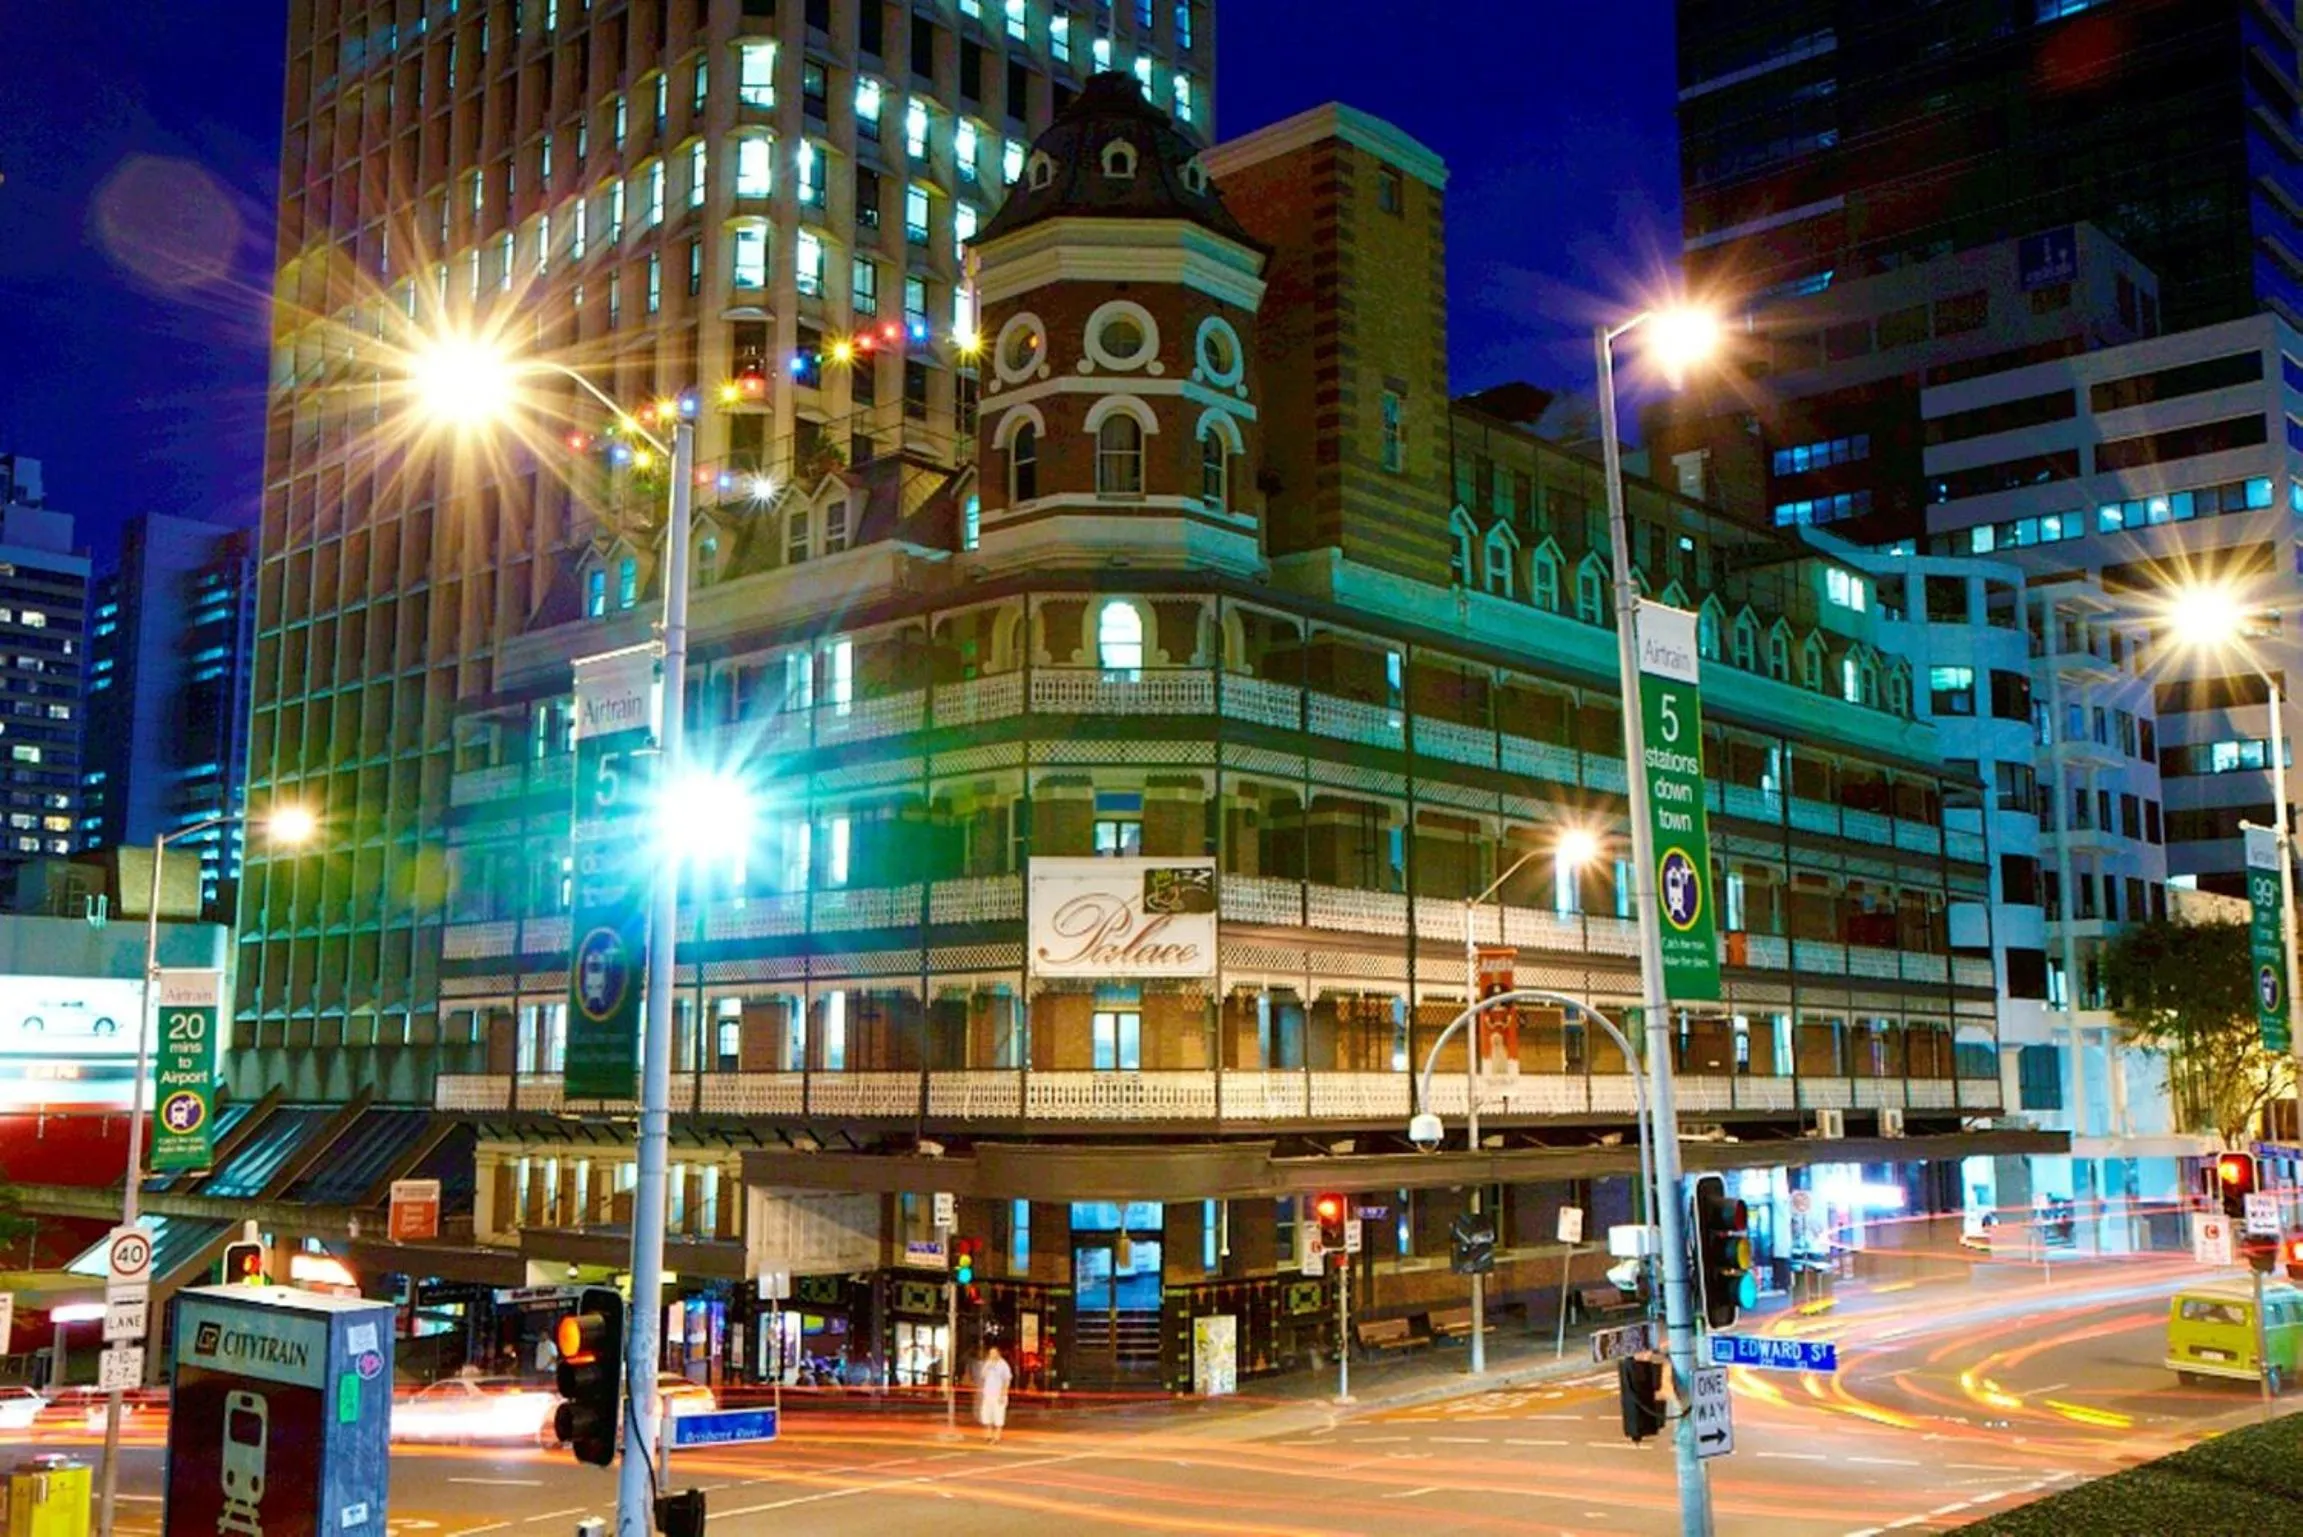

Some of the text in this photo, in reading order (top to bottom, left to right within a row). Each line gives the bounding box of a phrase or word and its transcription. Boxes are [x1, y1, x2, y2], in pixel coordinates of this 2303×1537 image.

[1643, 638, 1691, 674] Airtrain
[582, 690, 642, 726] Airtrain
[1661, 693, 1680, 742] 5
[1645, 746, 1698, 776] stations
[596, 752, 620, 806] 5
[1654, 775, 1692, 803] down
[1658, 806, 1692, 833] town
[1038, 891, 1199, 969] Palace
[166, 987, 212, 1001] Airtrain
[168, 1013, 205, 1040] 20
[169, 1041, 203, 1054] mins
[178, 1056, 192, 1069] to
[160, 1070, 208, 1086] Airport
[116, 1245, 143, 1264] 40
[108, 1314, 141, 1330] LANE
[223, 1330, 309, 1368] CITYTRAIN
[1738, 1339, 1802, 1361] EDWARD
[1697, 1373, 1723, 1397] ONE
[1698, 1402, 1725, 1421] WAY
